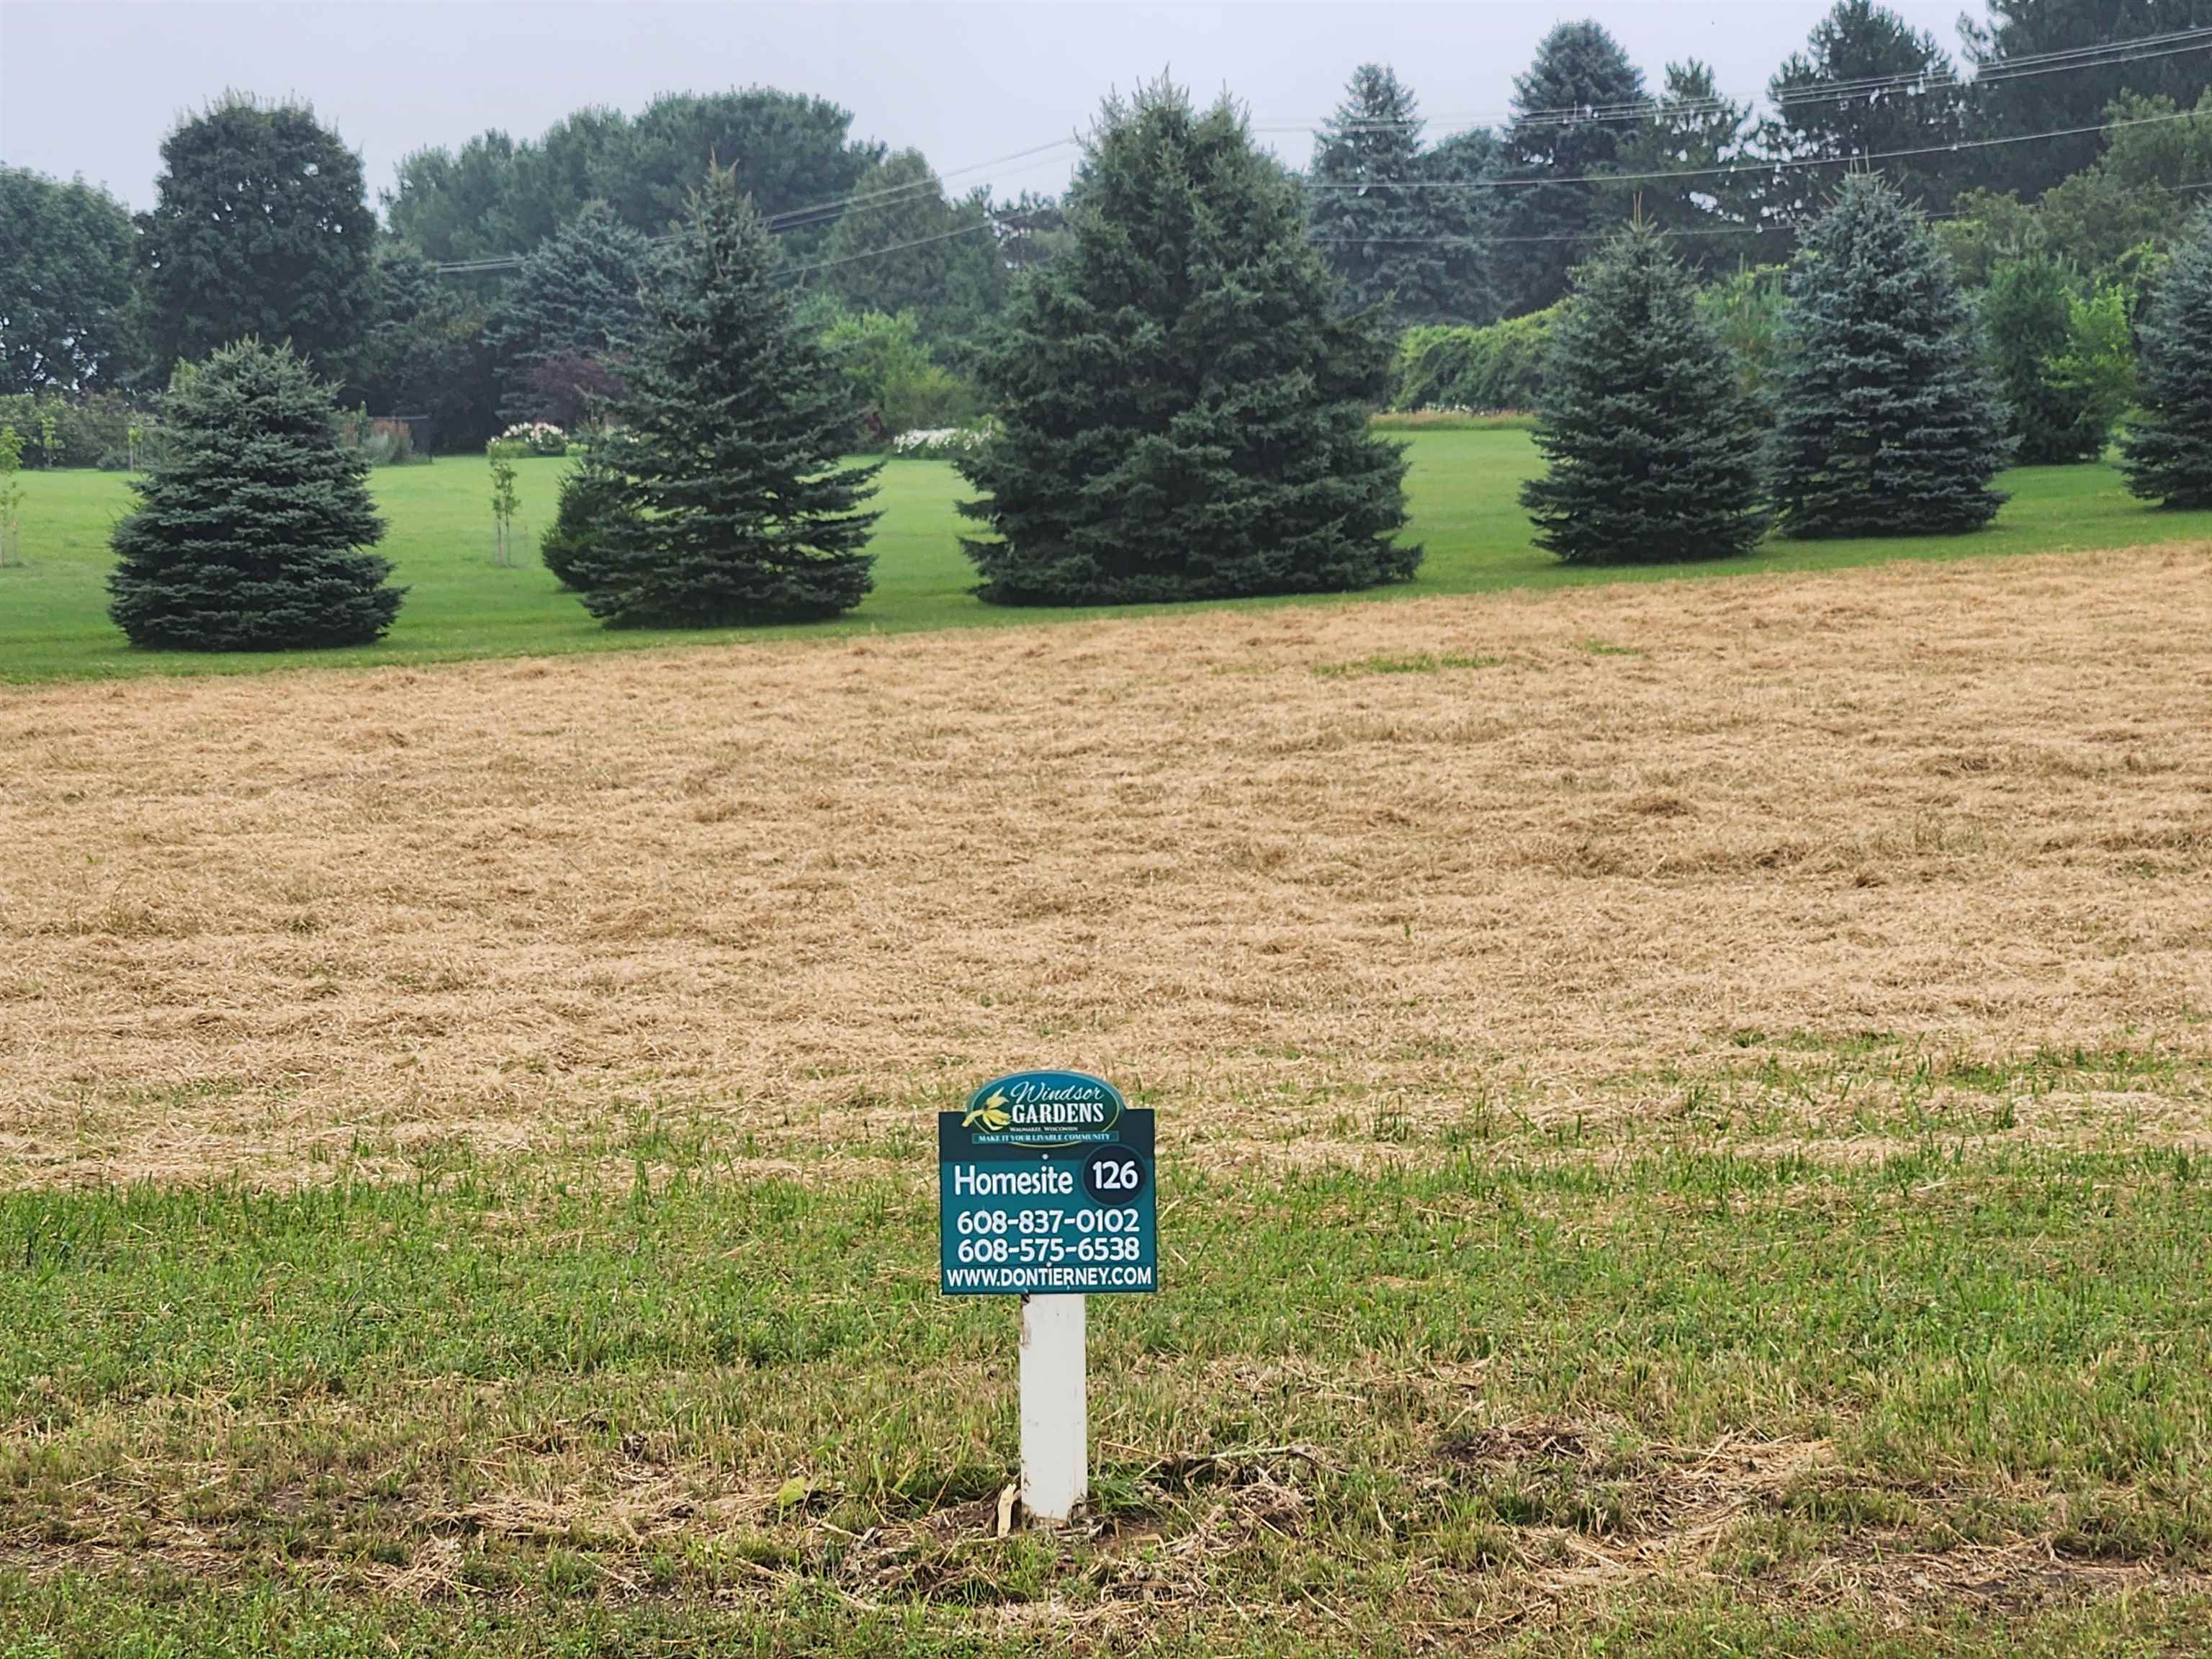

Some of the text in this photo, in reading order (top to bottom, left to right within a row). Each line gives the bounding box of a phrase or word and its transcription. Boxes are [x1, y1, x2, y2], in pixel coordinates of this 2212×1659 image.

[1010, 1081, 1103, 1102] Windsor
[1012, 1102, 1104, 1123] GARDENS
[954, 1164, 1073, 1195] Homesite
[1092, 1161, 1138, 1190] 126
[957, 1208, 1141, 1234] 608-837-0102
[958, 1237, 1140, 1262] 608-575-6538
[947, 1267, 1151, 1287] WWW.DONTIERNEY.COM
